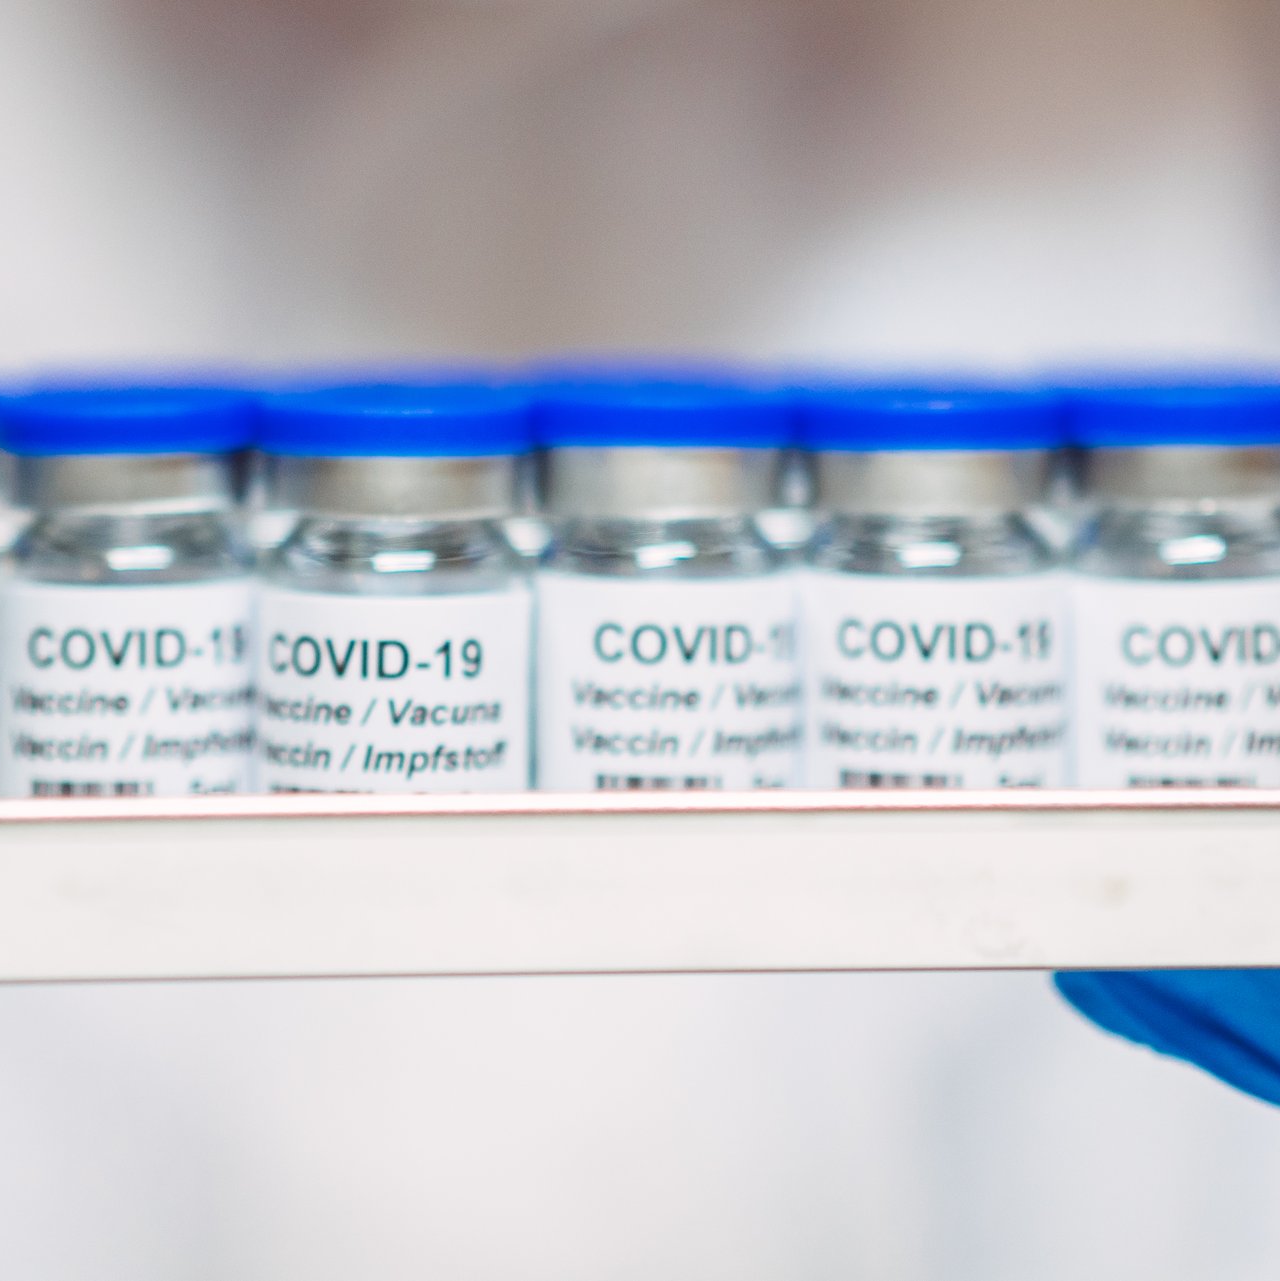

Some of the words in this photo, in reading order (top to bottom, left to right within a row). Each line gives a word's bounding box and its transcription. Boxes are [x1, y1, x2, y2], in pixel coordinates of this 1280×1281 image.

[271, 632, 483, 679] COVID-19
[265, 692, 352, 725] ccine
[265, 740, 332, 772] ccin
